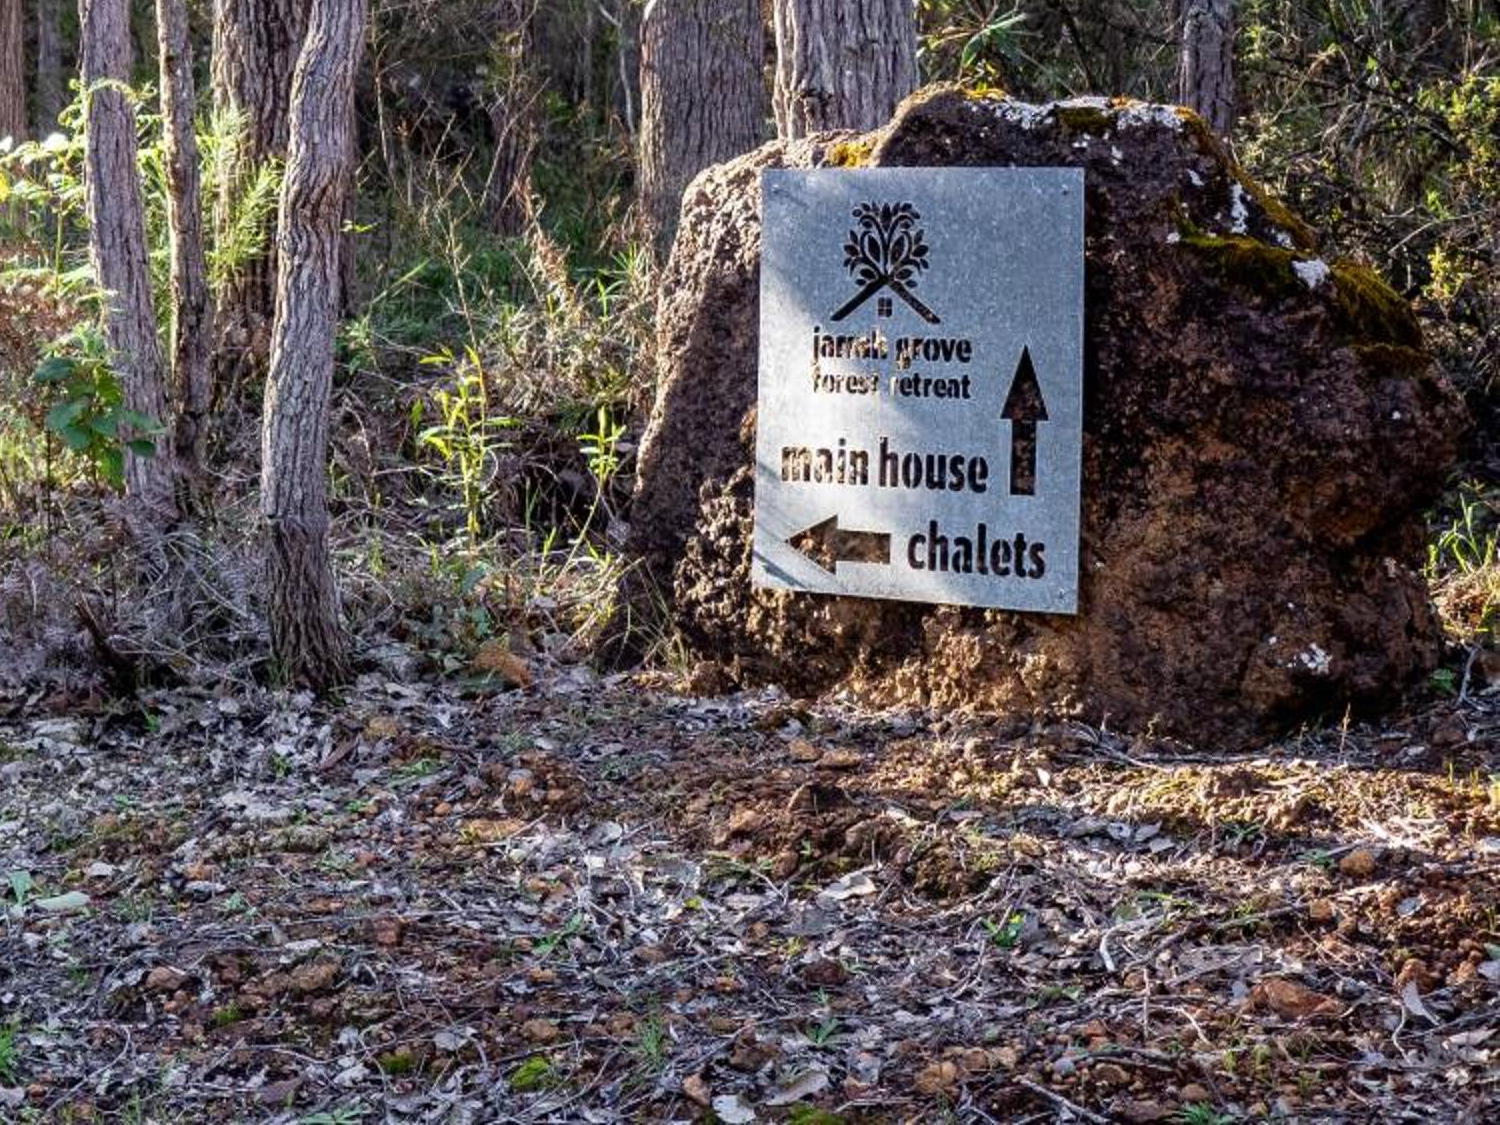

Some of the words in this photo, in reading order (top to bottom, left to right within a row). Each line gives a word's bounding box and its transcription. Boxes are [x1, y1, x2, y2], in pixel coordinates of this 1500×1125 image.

[895, 337, 972, 369] grove
[813, 366, 879, 394] forest
[889, 372, 971, 399] retreat
[781, 437, 869, 486] main
[879, 436, 989, 494] house
[907, 520, 1046, 580] chalets
